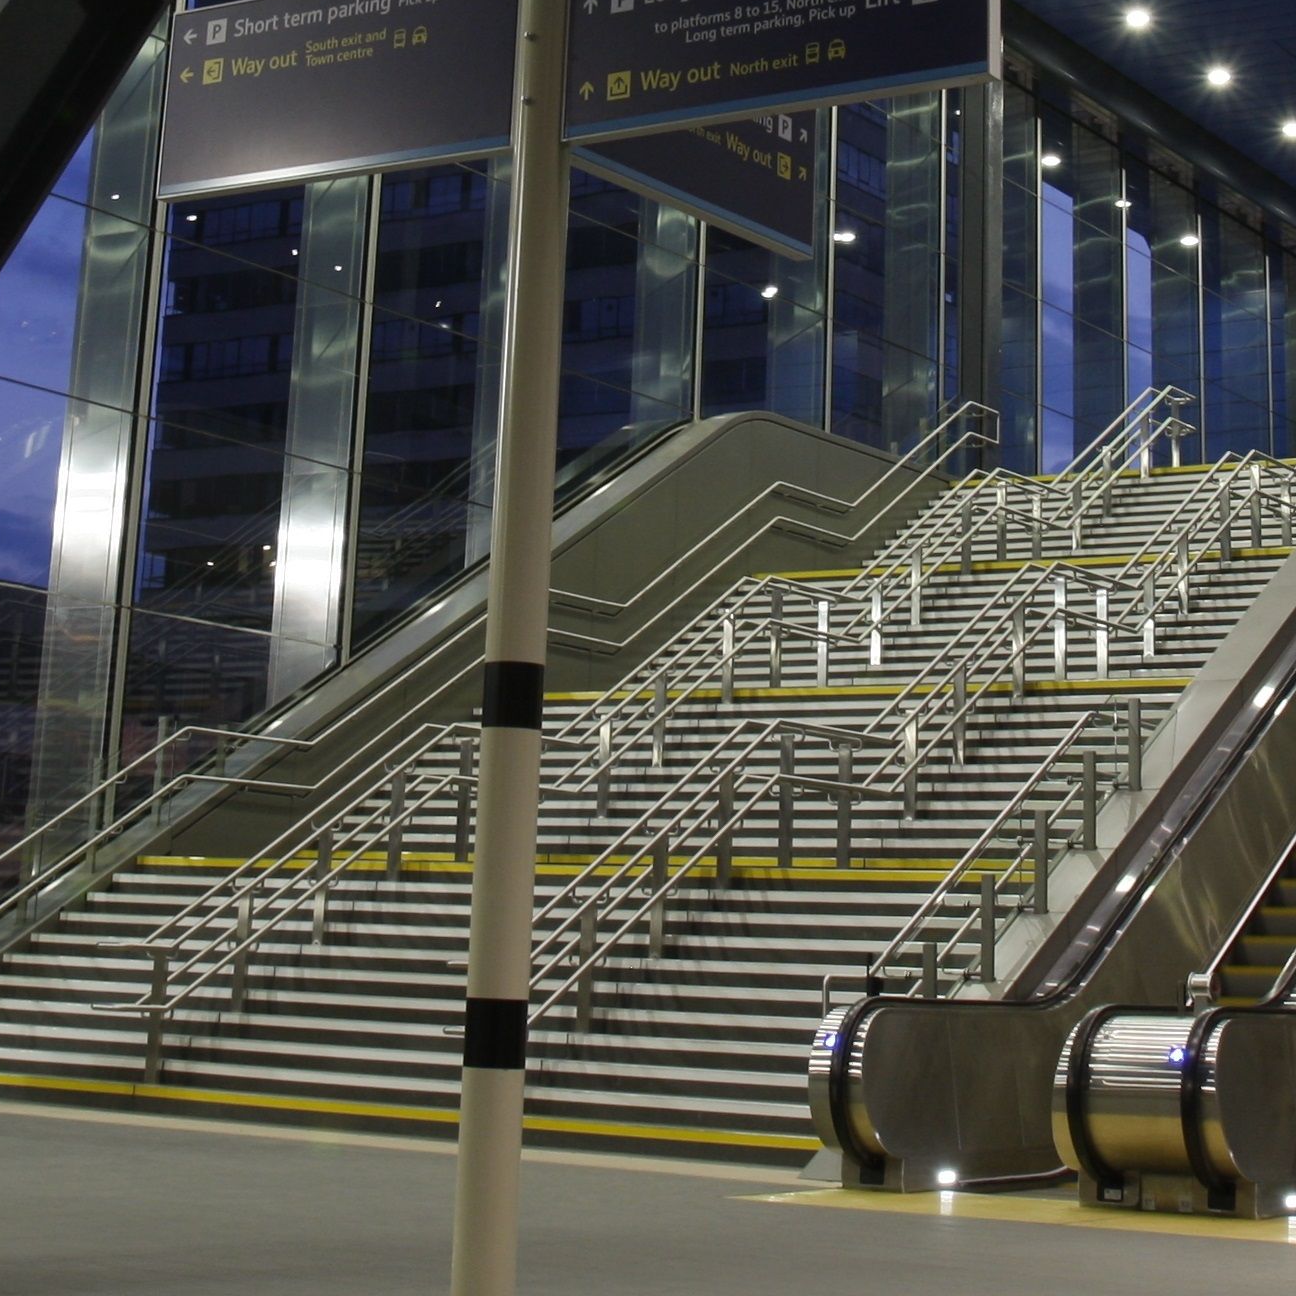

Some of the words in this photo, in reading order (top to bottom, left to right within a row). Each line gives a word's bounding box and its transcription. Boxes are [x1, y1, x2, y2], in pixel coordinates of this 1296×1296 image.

[233, 15, 279, 37] Short
[284, 8, 323, 28] term
[655, 23, 668, 33] to
[671, 12, 731, 34] platforms
[734, 6, 742, 19] 8
[746, 6, 760, 18] to
[685, 29, 717, 43] Long
[720, 23, 750, 37] term
[809, 6, 836, 22] Pick
[839, 5, 856, 18] up
[305, 36, 339, 53] South
[341, 33, 362, 47] exit
[365, 28, 387, 42] and
[231, 57, 265, 77] Way
[269, 50, 298, 69] out
[305, 52, 334, 67] Town
[337, 47, 374, 62] centre
[640, 69, 681, 92] Way
[687, 61, 721, 84] out
[730, 57, 769, 76] North
[772, 53, 799, 70] exit
[726, 131, 750, 161] Way
[753, 149, 772, 168] out
